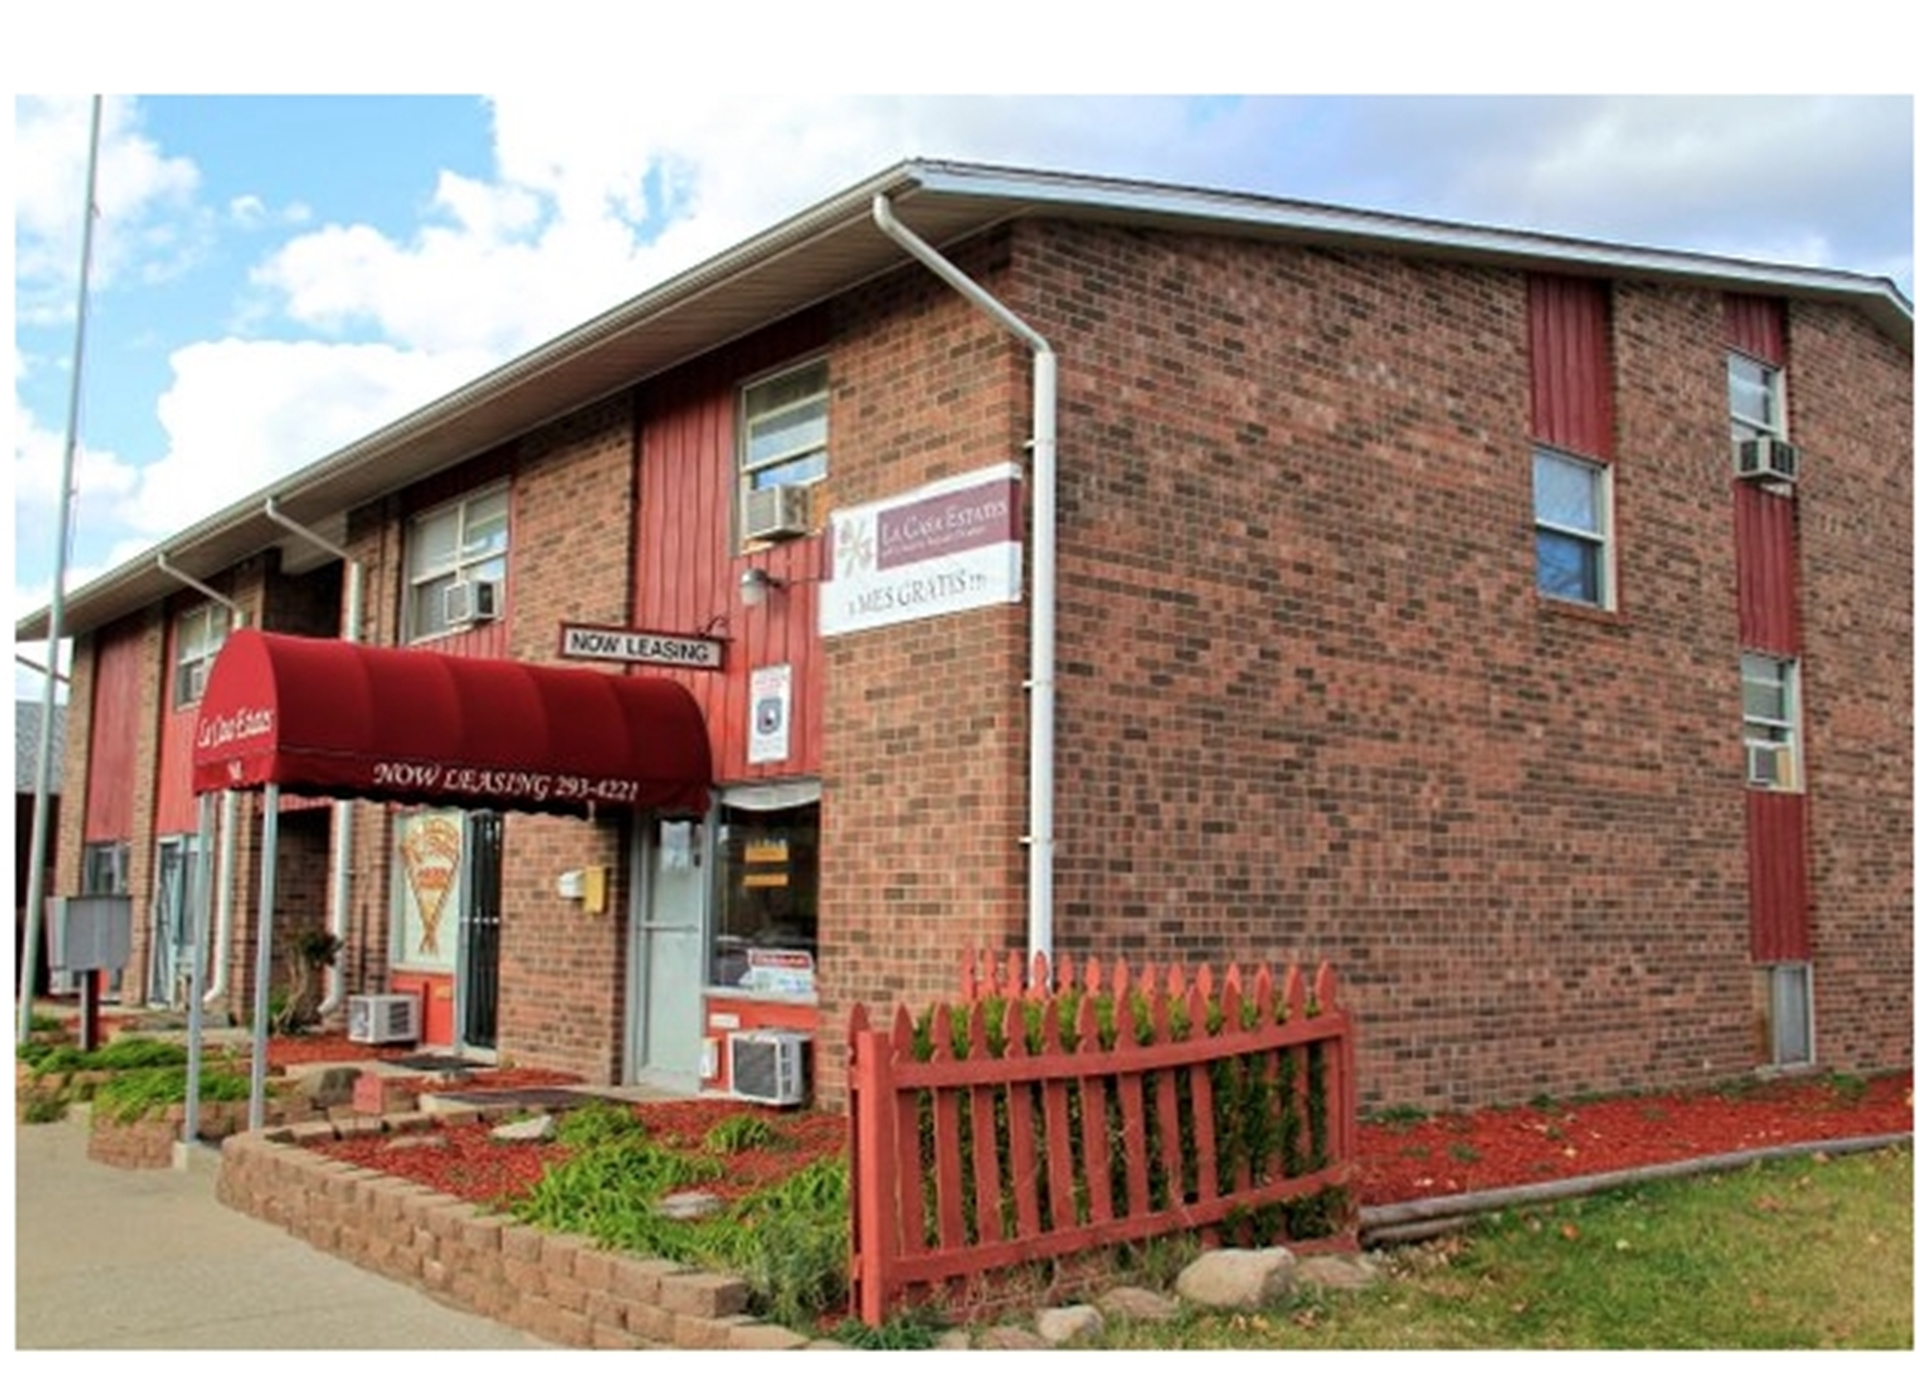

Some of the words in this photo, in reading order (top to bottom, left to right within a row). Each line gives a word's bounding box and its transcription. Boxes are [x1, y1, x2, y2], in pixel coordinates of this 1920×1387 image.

[858, 585, 894, 613] MES
[897, 568, 966, 607] GRATIS
[571, 632, 621, 654] NOW
[625, 637, 710, 663] LEASING
[373, 762, 441, 787] NOW
[443, 767, 551, 802] LEASING
[554, 773, 640, 802] 293-4221
